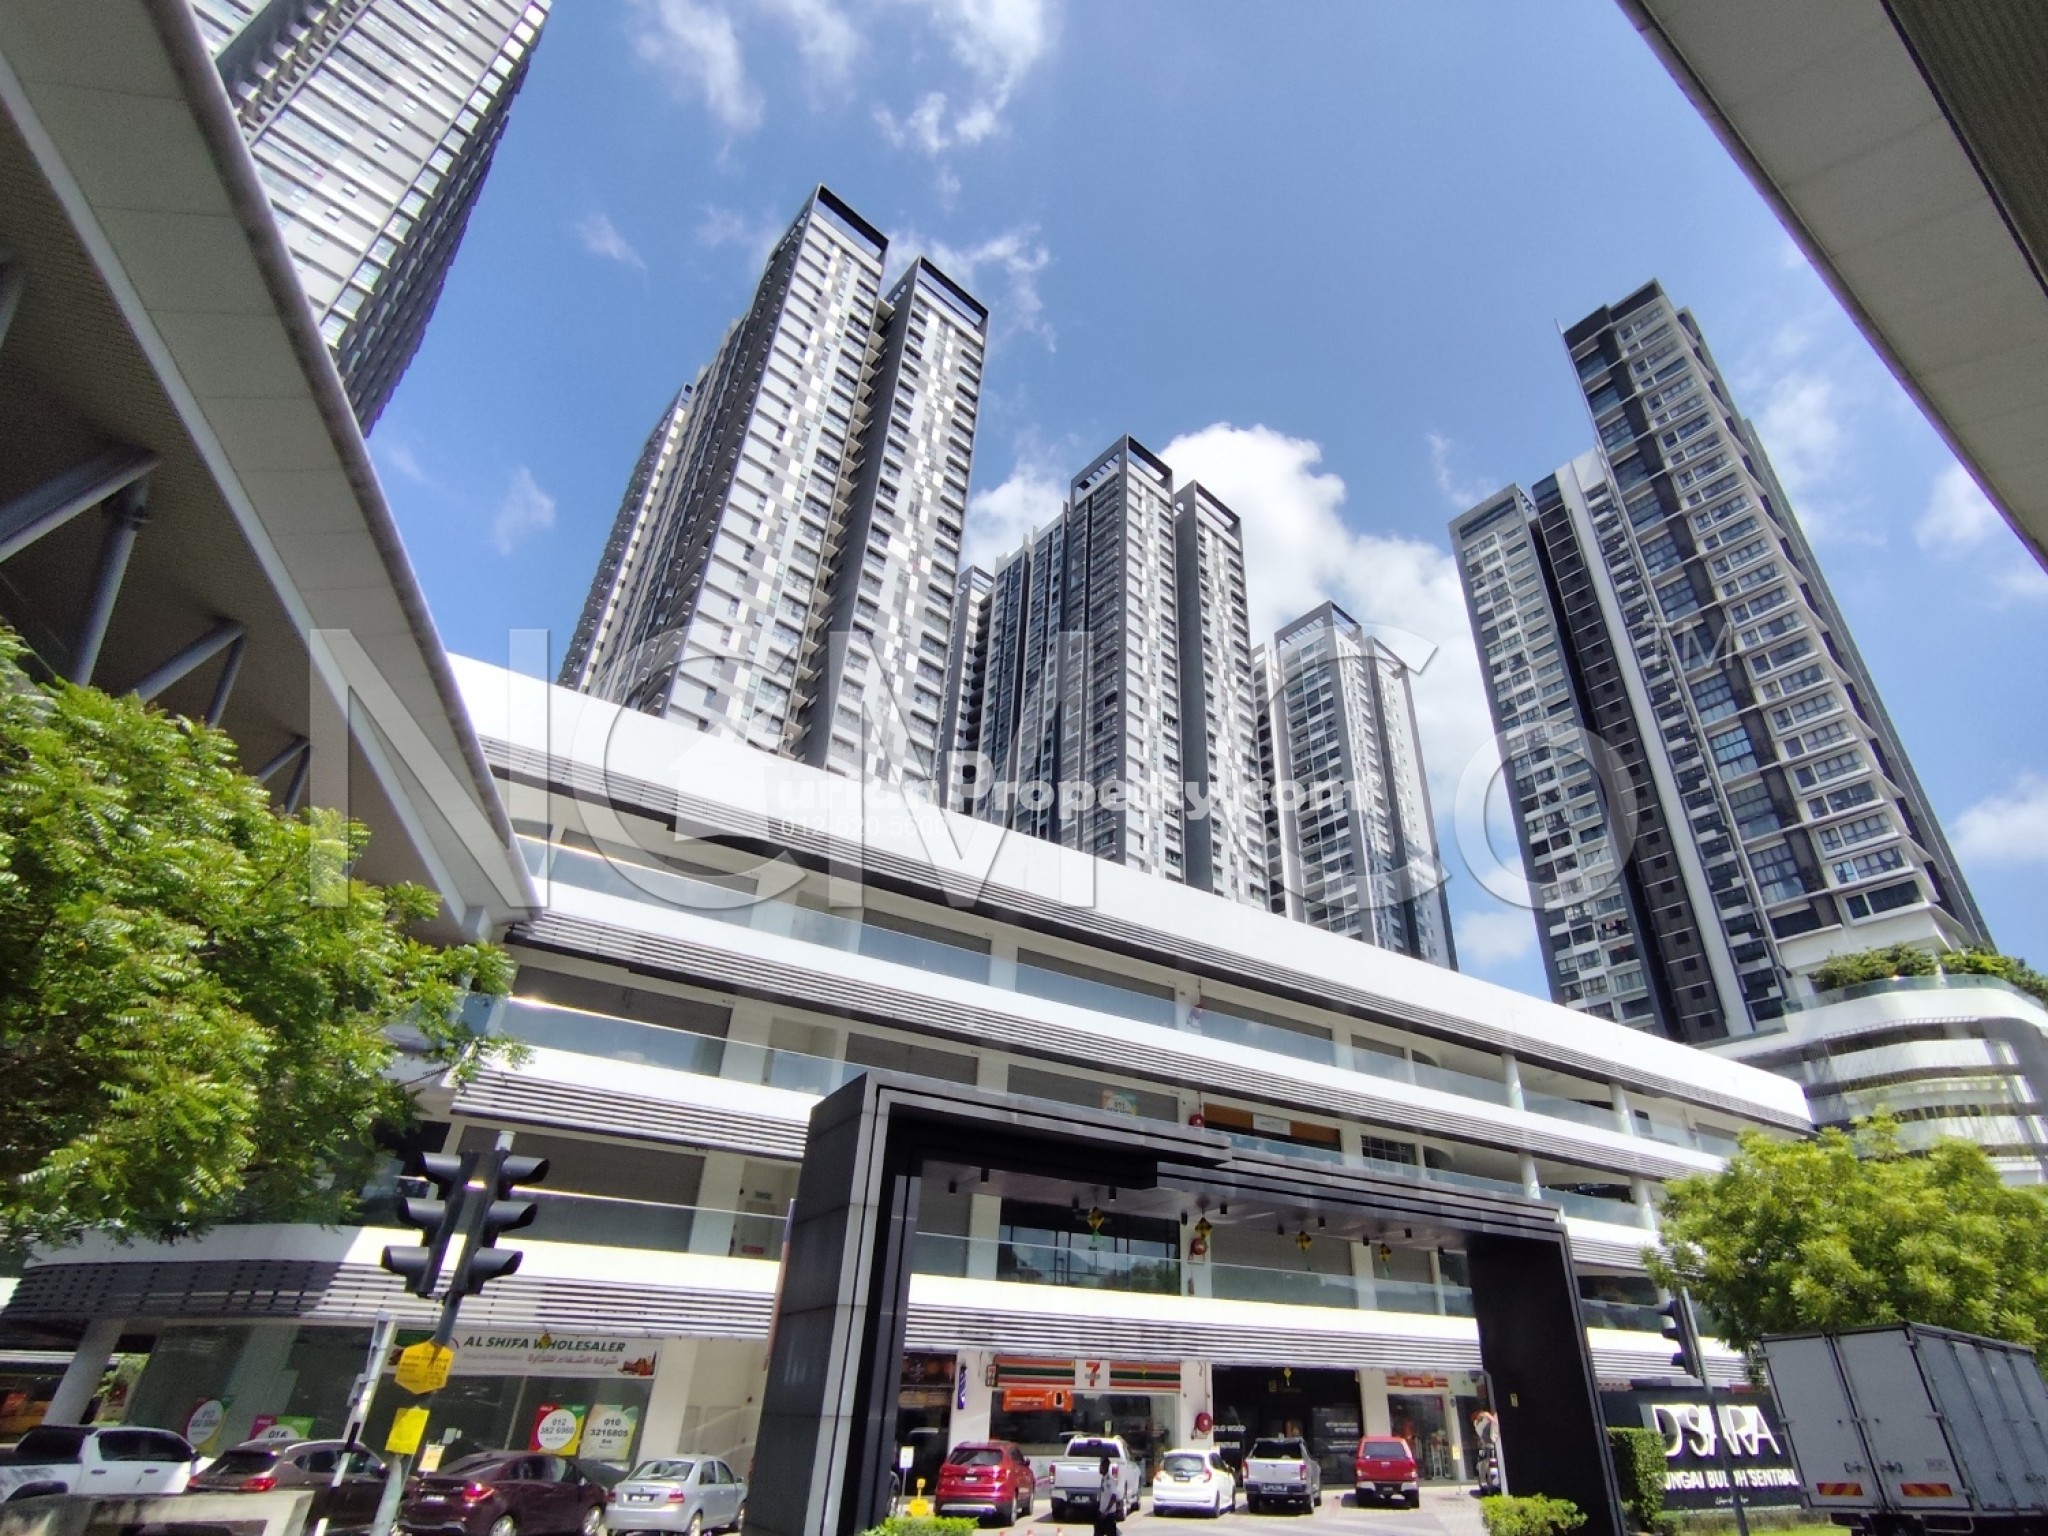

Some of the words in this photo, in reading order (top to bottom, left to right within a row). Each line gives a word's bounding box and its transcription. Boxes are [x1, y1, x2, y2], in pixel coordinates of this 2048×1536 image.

[464, 1336, 483, 1347] AL
[486, 1337, 529, 1349] SHIFA
[1747, 1469, 1800, 1487] SENTRAL
